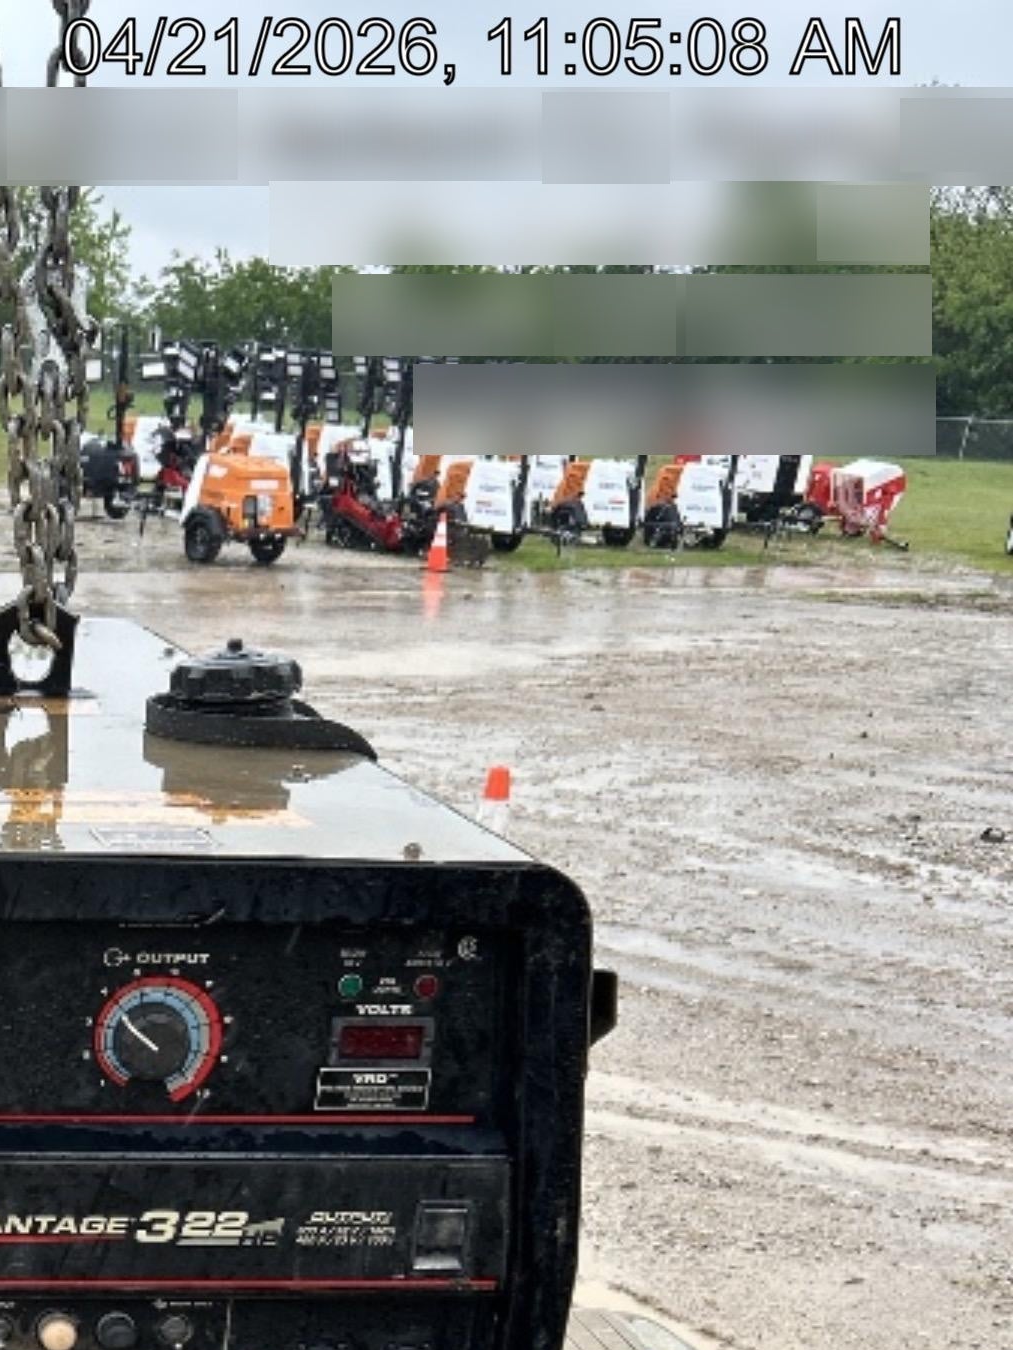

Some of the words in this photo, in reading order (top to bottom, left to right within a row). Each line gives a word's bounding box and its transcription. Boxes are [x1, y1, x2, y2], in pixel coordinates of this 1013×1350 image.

[136, 952, 210, 965] OUTPUT
[355, 1004, 414, 1016] VOLTS
[136, 1209, 250, 1243] 322
